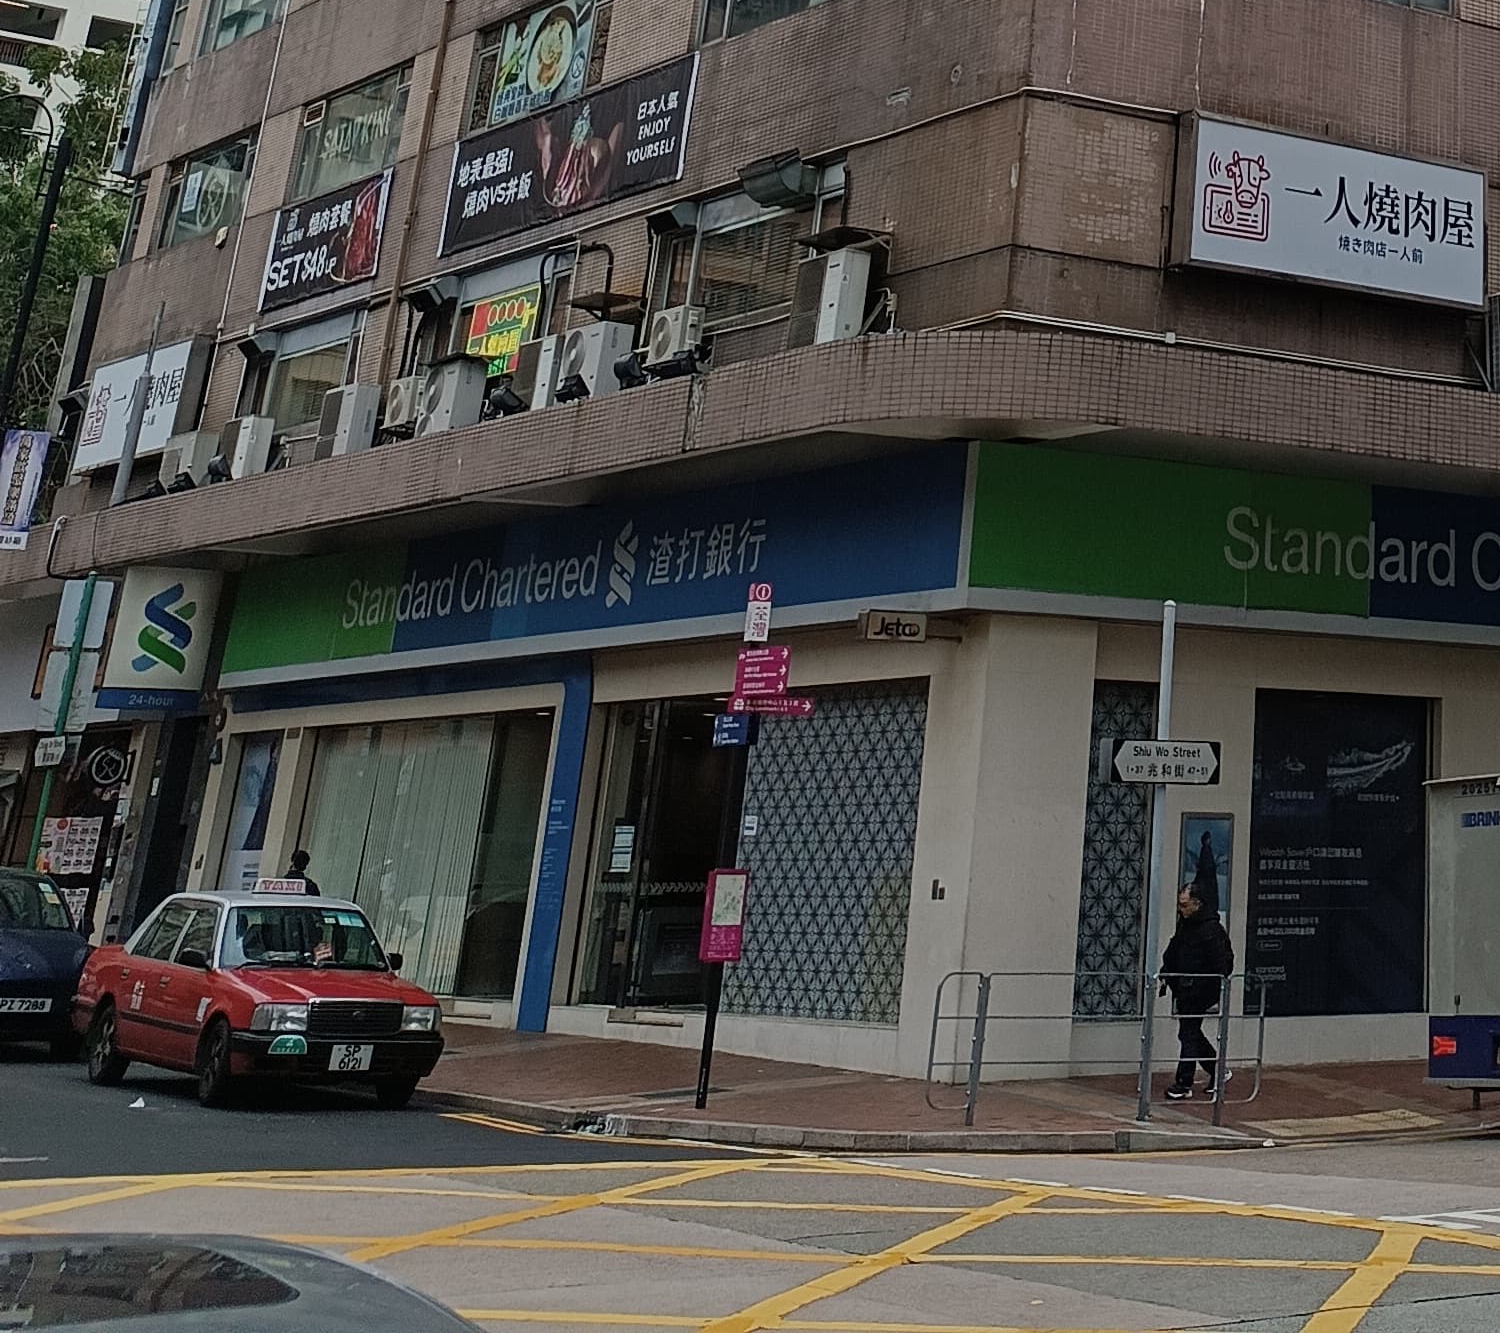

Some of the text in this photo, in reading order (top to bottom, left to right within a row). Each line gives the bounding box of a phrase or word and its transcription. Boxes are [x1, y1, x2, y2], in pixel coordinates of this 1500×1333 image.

[638, 116, 672, 141] ENJOY
[626, 136, 676, 166] YOURSELF
[1285, 176, 1475, 249] 一人燒肉屋
[1338, 234, 1424, 264] 焼き肉店一人前
[1223, 505, 1457, 588] Standard
[342, 517, 768, 630] Standard Chartered 渣打銀行
[128, 694, 174, 706] 24-hour
[1133, 745, 1201, 758] Shiu Wo Street
[262, 879, 304, 892] TAXI
[339, 1057, 362, 1070] 6121
[345, 1045, 362, 1058] SP
